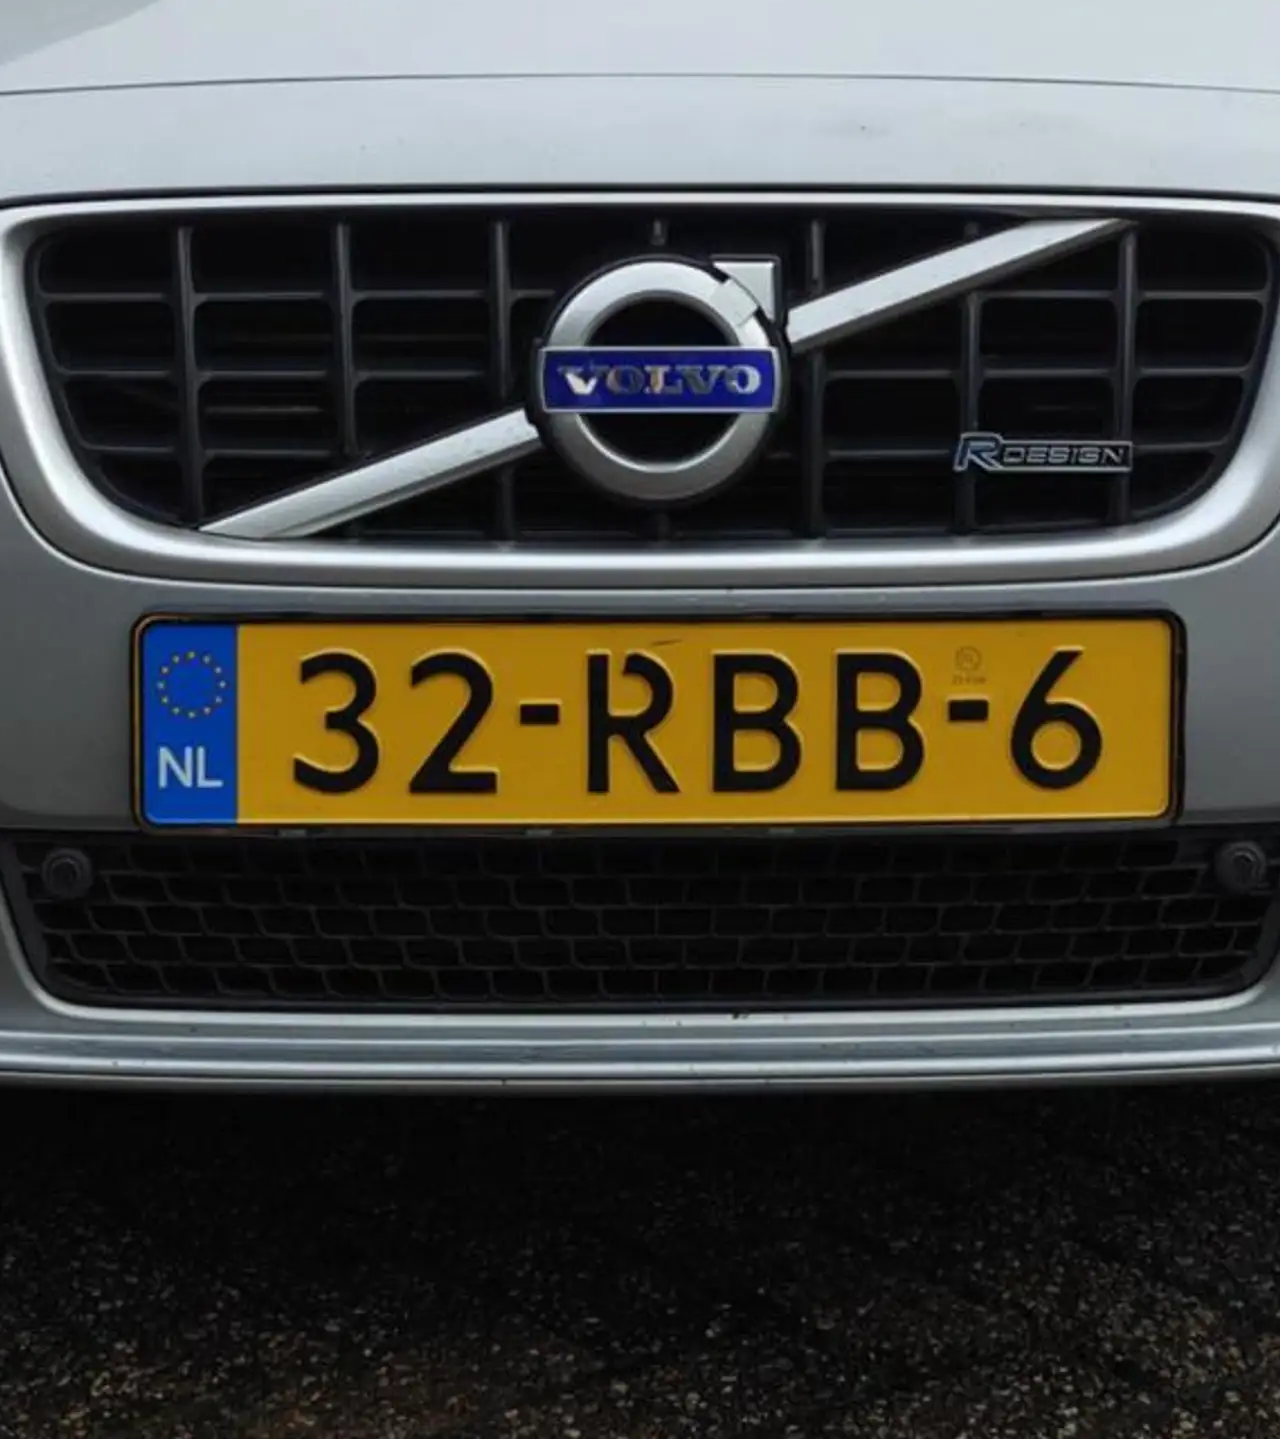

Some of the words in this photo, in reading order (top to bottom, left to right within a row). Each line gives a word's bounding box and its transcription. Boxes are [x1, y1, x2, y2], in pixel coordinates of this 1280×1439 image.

[557, 363, 762, 396] VOLVO
[291, 646, 1104, 796] 32-RBB-6
[157, 747, 222, 789] NL
